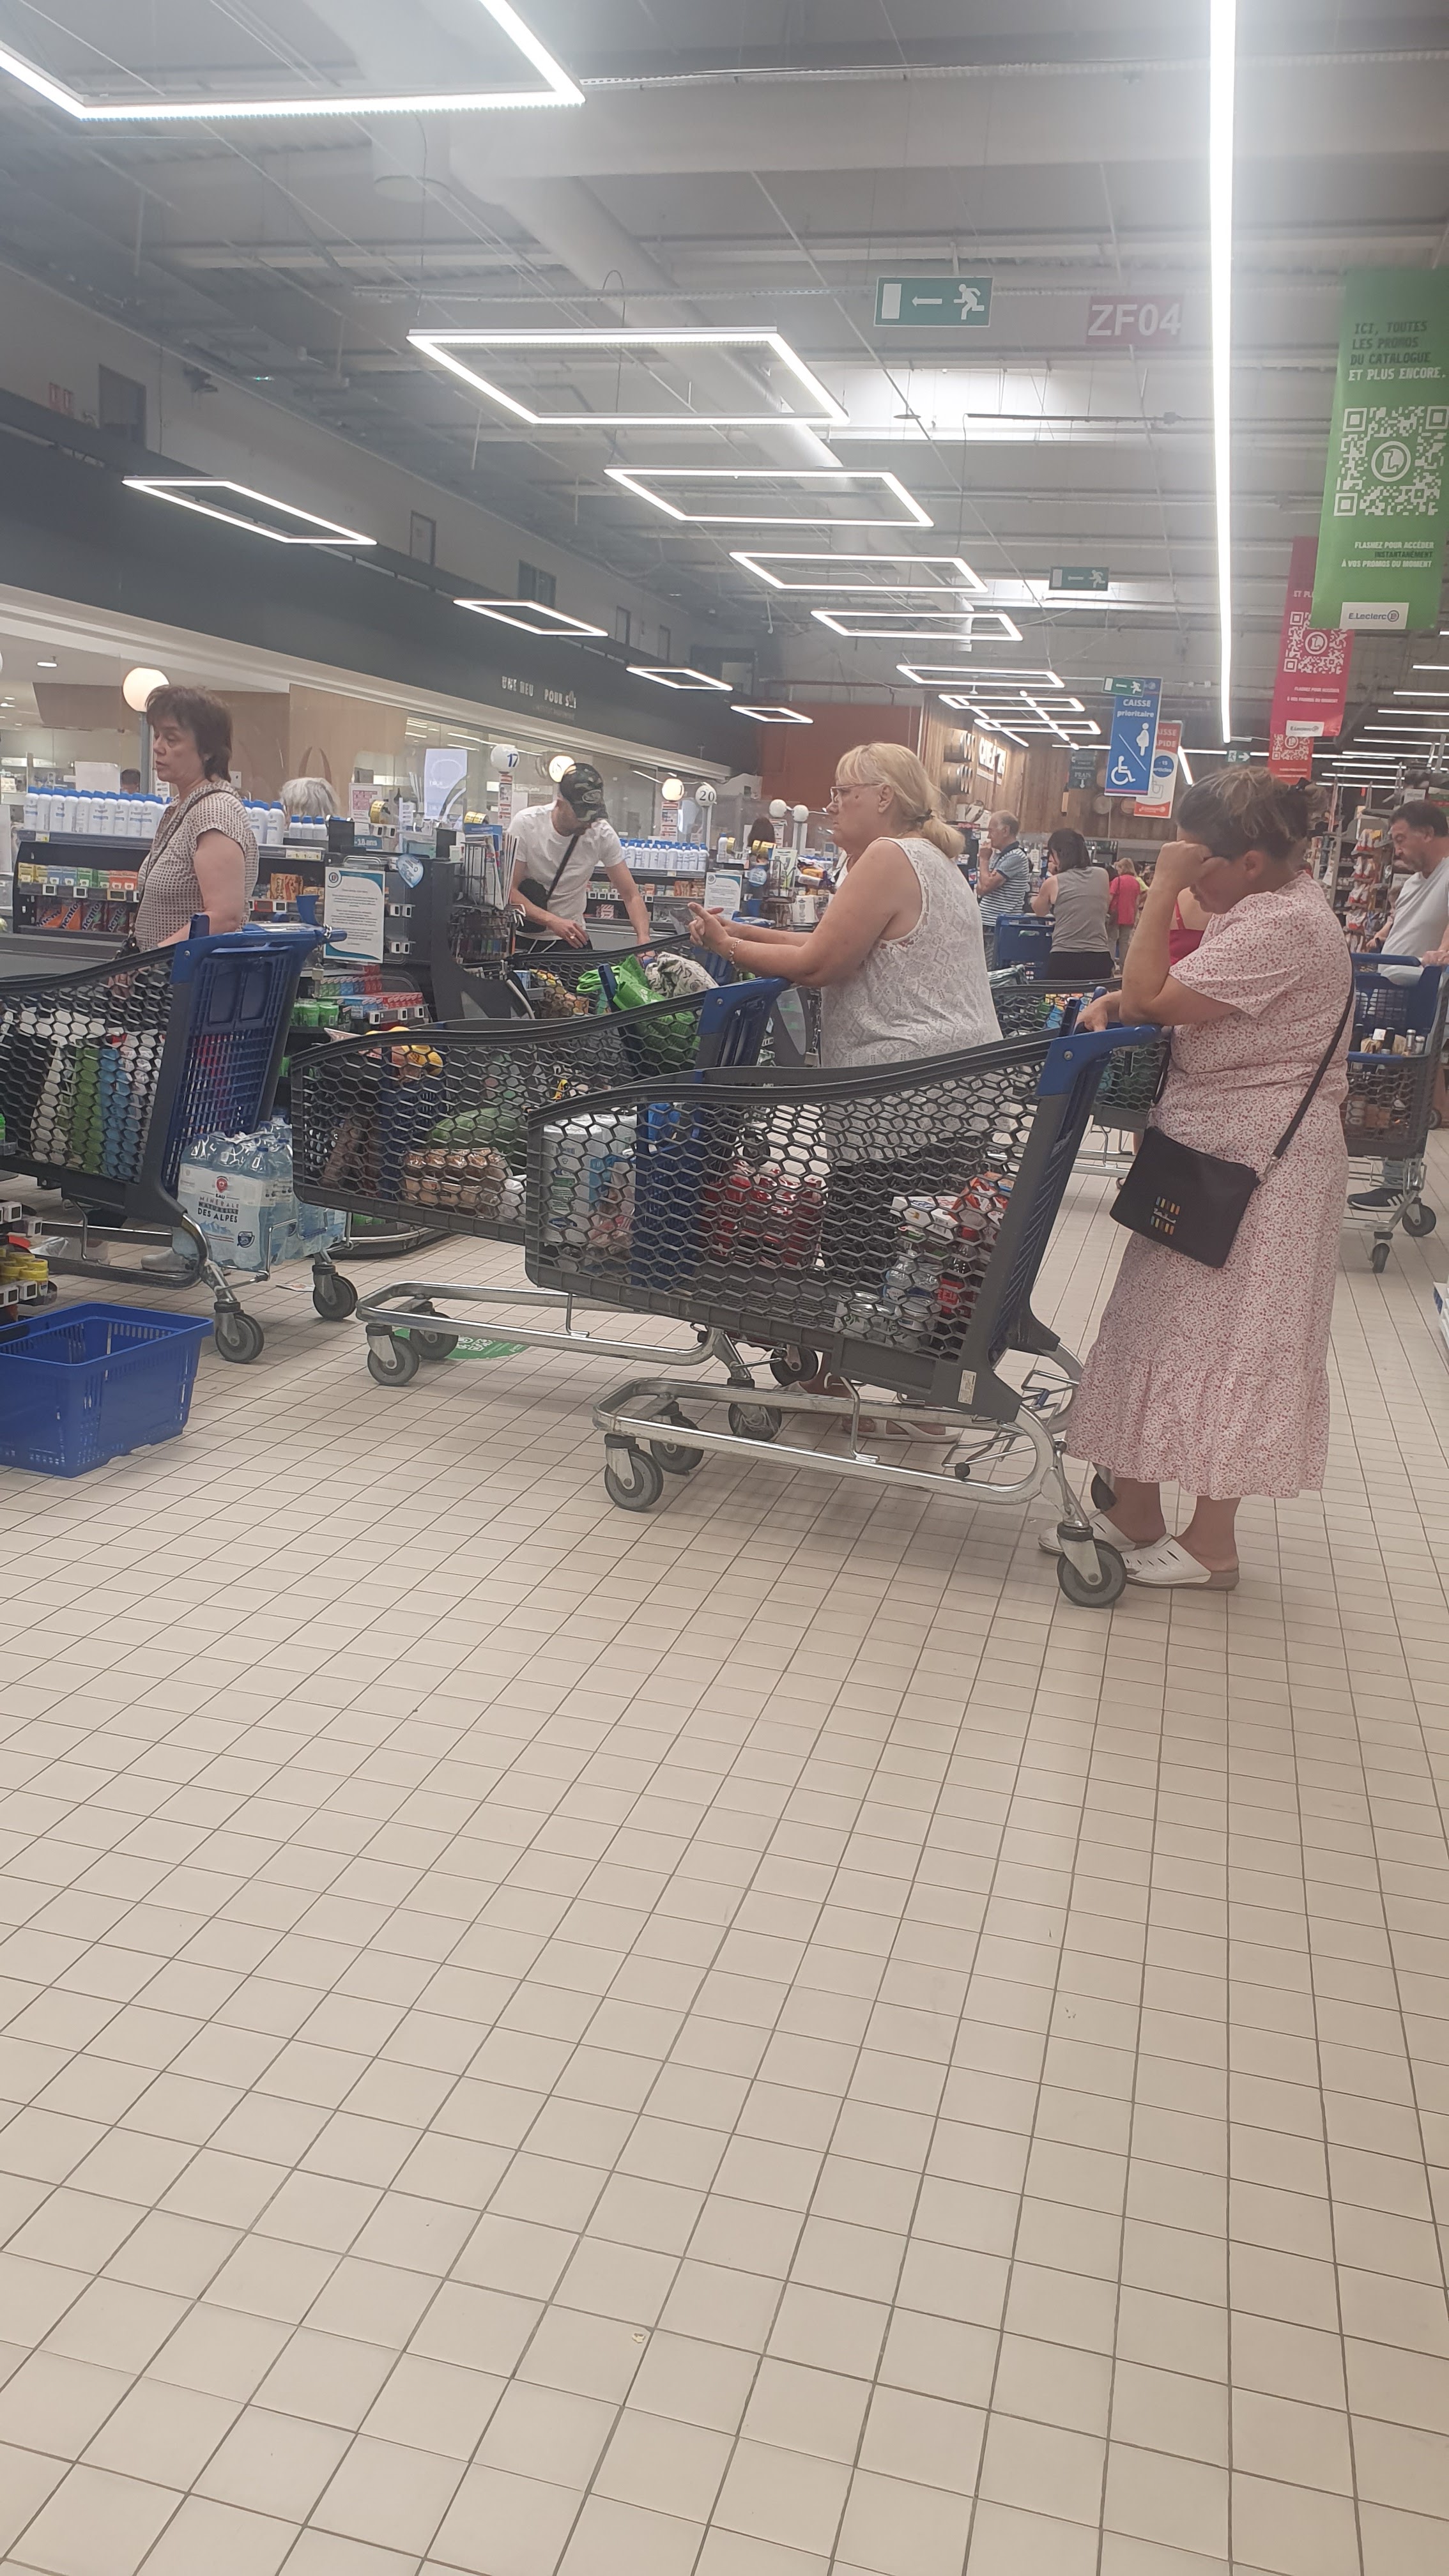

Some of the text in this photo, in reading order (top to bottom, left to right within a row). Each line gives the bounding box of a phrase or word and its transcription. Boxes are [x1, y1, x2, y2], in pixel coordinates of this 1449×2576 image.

[1088, 303, 1181, 336] ZF04
[1355, 321, 1427, 335] ICI, TOUTES
[1353, 337, 1419, 350] LES PROMOS
[1350, 352, 1431, 365] DU CATALOGUE
[1348, 367, 1446, 381] ET PLUS ENCORE.
[544, 689, 562, 705] POUR
[1123, 699, 1151, 707] CAISSE
[507, 753, 519, 767] 17
[700, 790, 715, 802] 20
[198, 1208, 238, 1223] DES ALPES
